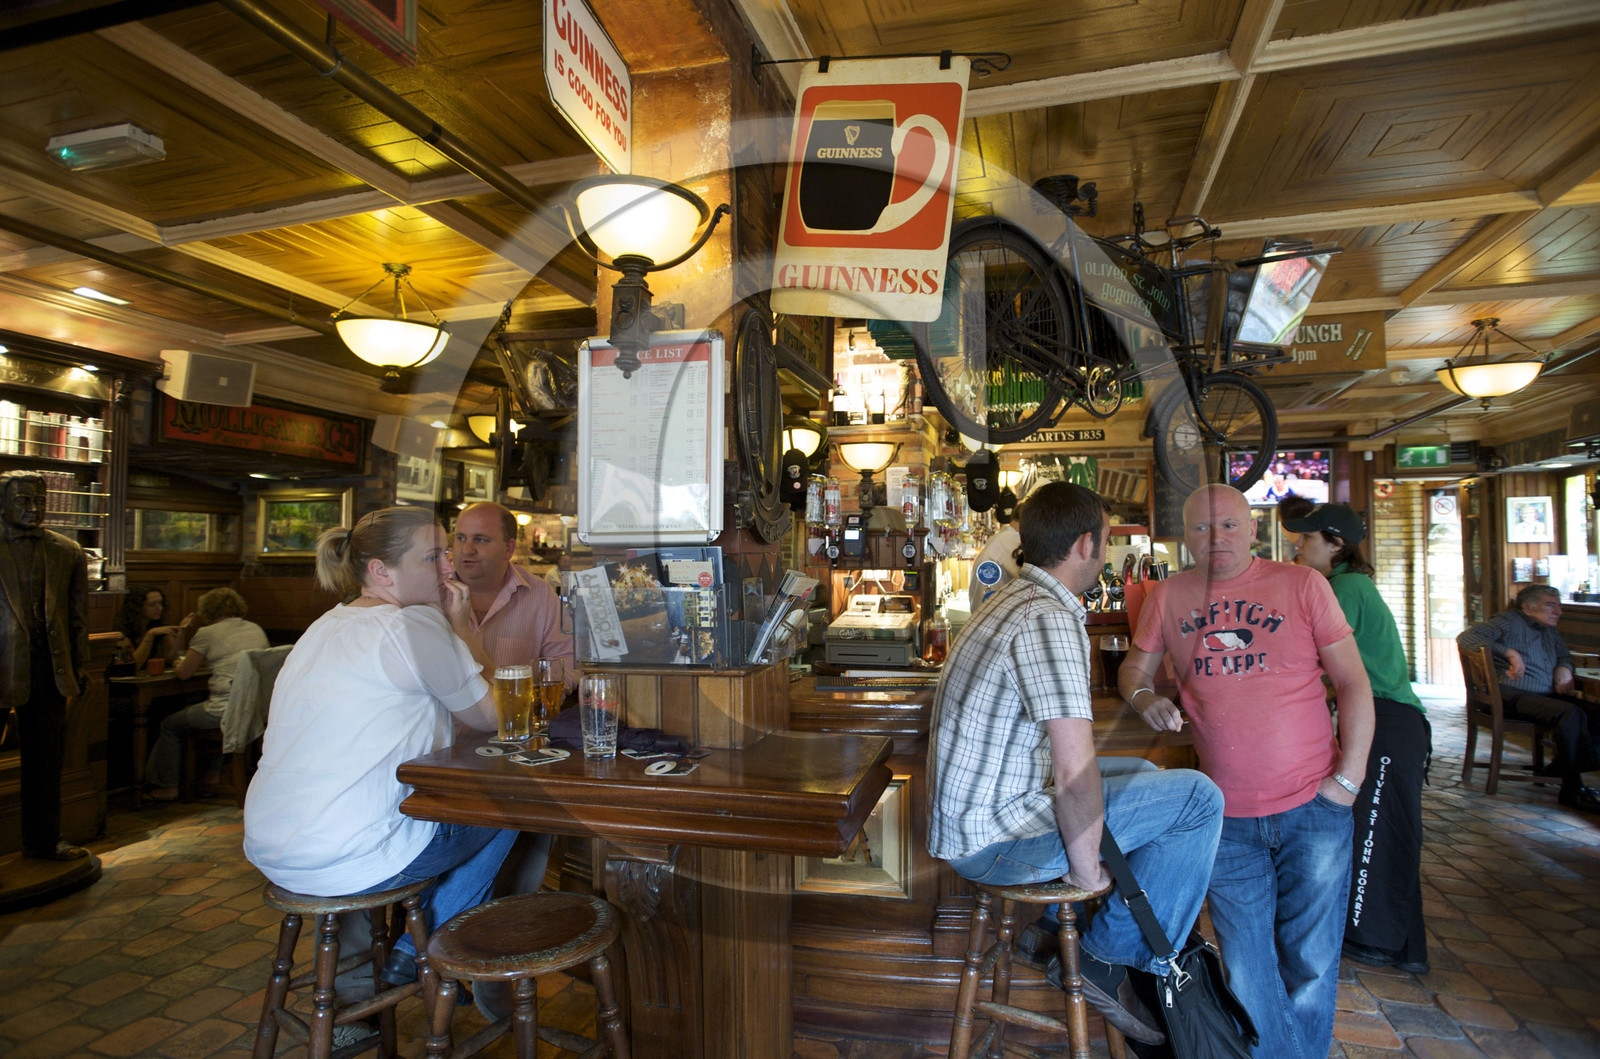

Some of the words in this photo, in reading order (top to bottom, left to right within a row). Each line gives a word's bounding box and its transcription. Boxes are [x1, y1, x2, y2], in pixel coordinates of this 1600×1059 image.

[553, 0, 628, 122] GUINNESS
[554, 48, 565, 77] IS
[567, 67, 594, 112] GOOD
[595, 100, 611, 135] FOR
[612, 121, 627, 152] YOU
[816, 147, 883, 159] GUINNESS
[778, 264, 939, 295] GUINNESS
[1085, 261, 1128, 283] OLIVER
[1147, 285, 1171, 312] JOHN
[1291, 323, 1343, 344] UNCH
[656, 347, 684, 359] LIST
[170, 402, 302, 442] MULLIGAN
[1079, 430, 1102, 440] 1835
[1371, 756, 1391, 805] OLIVER
[1369, 809, 1378, 826] ST
[1361, 830, 1374, 864] JOHN
[1352, 869, 1368, 927] GOGARTY
